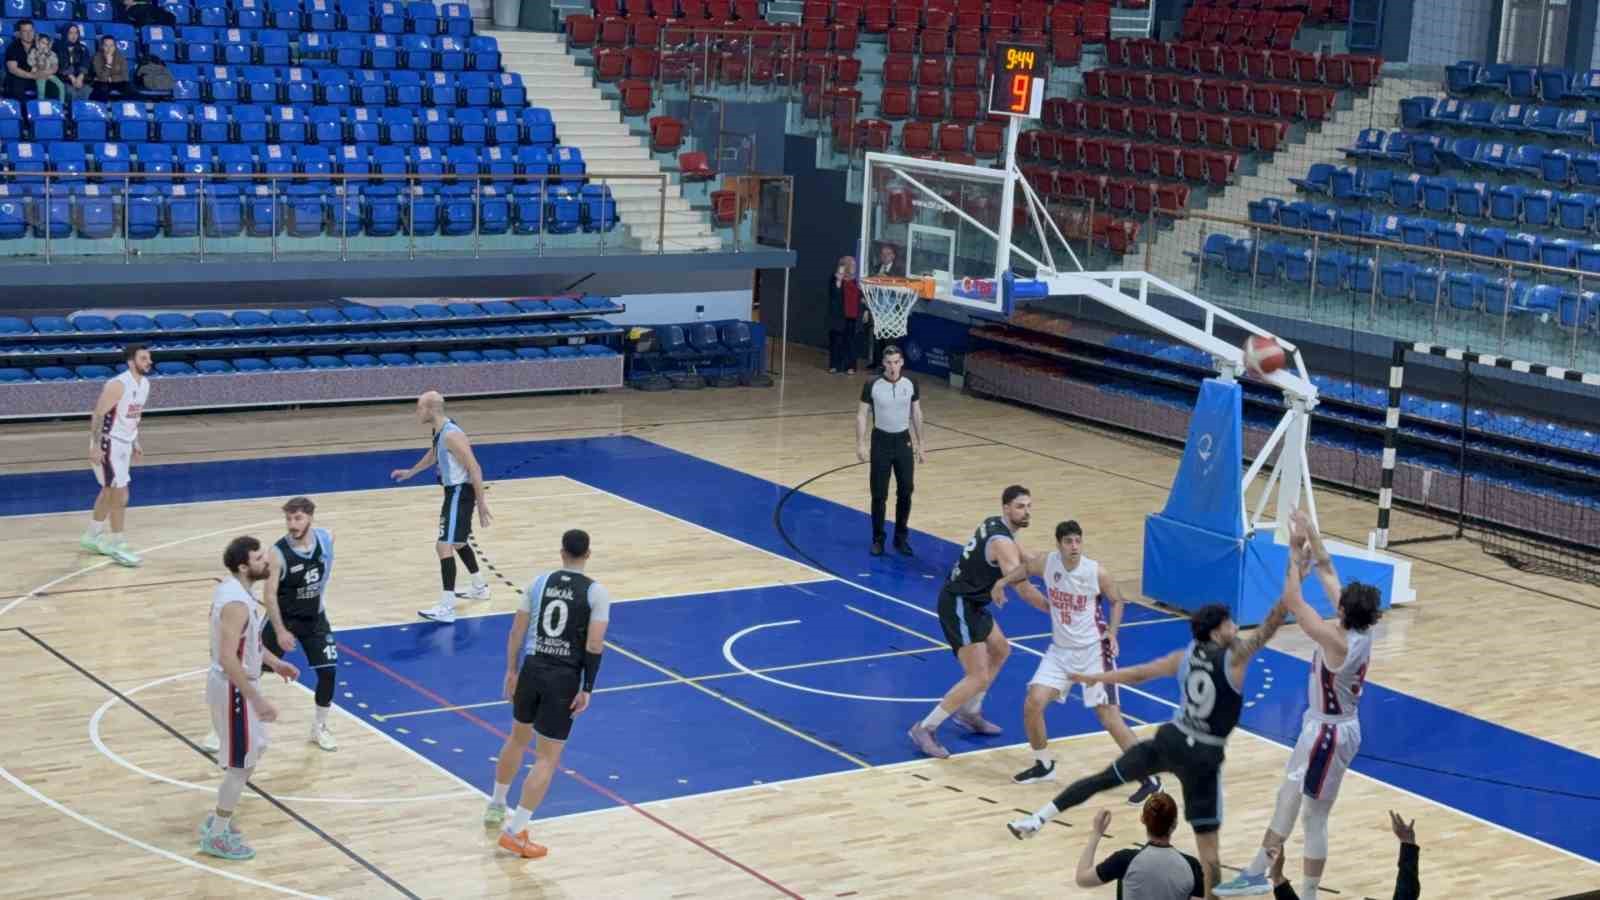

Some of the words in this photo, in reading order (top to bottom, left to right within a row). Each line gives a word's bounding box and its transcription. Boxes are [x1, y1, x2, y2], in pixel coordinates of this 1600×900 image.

[1006, 48, 1035, 70] 9:44
[1011, 75, 1029, 111] 9
[303, 567, 320, 584] 15
[542, 599, 568, 637] 0
[323, 644, 338, 660] 15
[1187, 670, 1216, 719] 9
